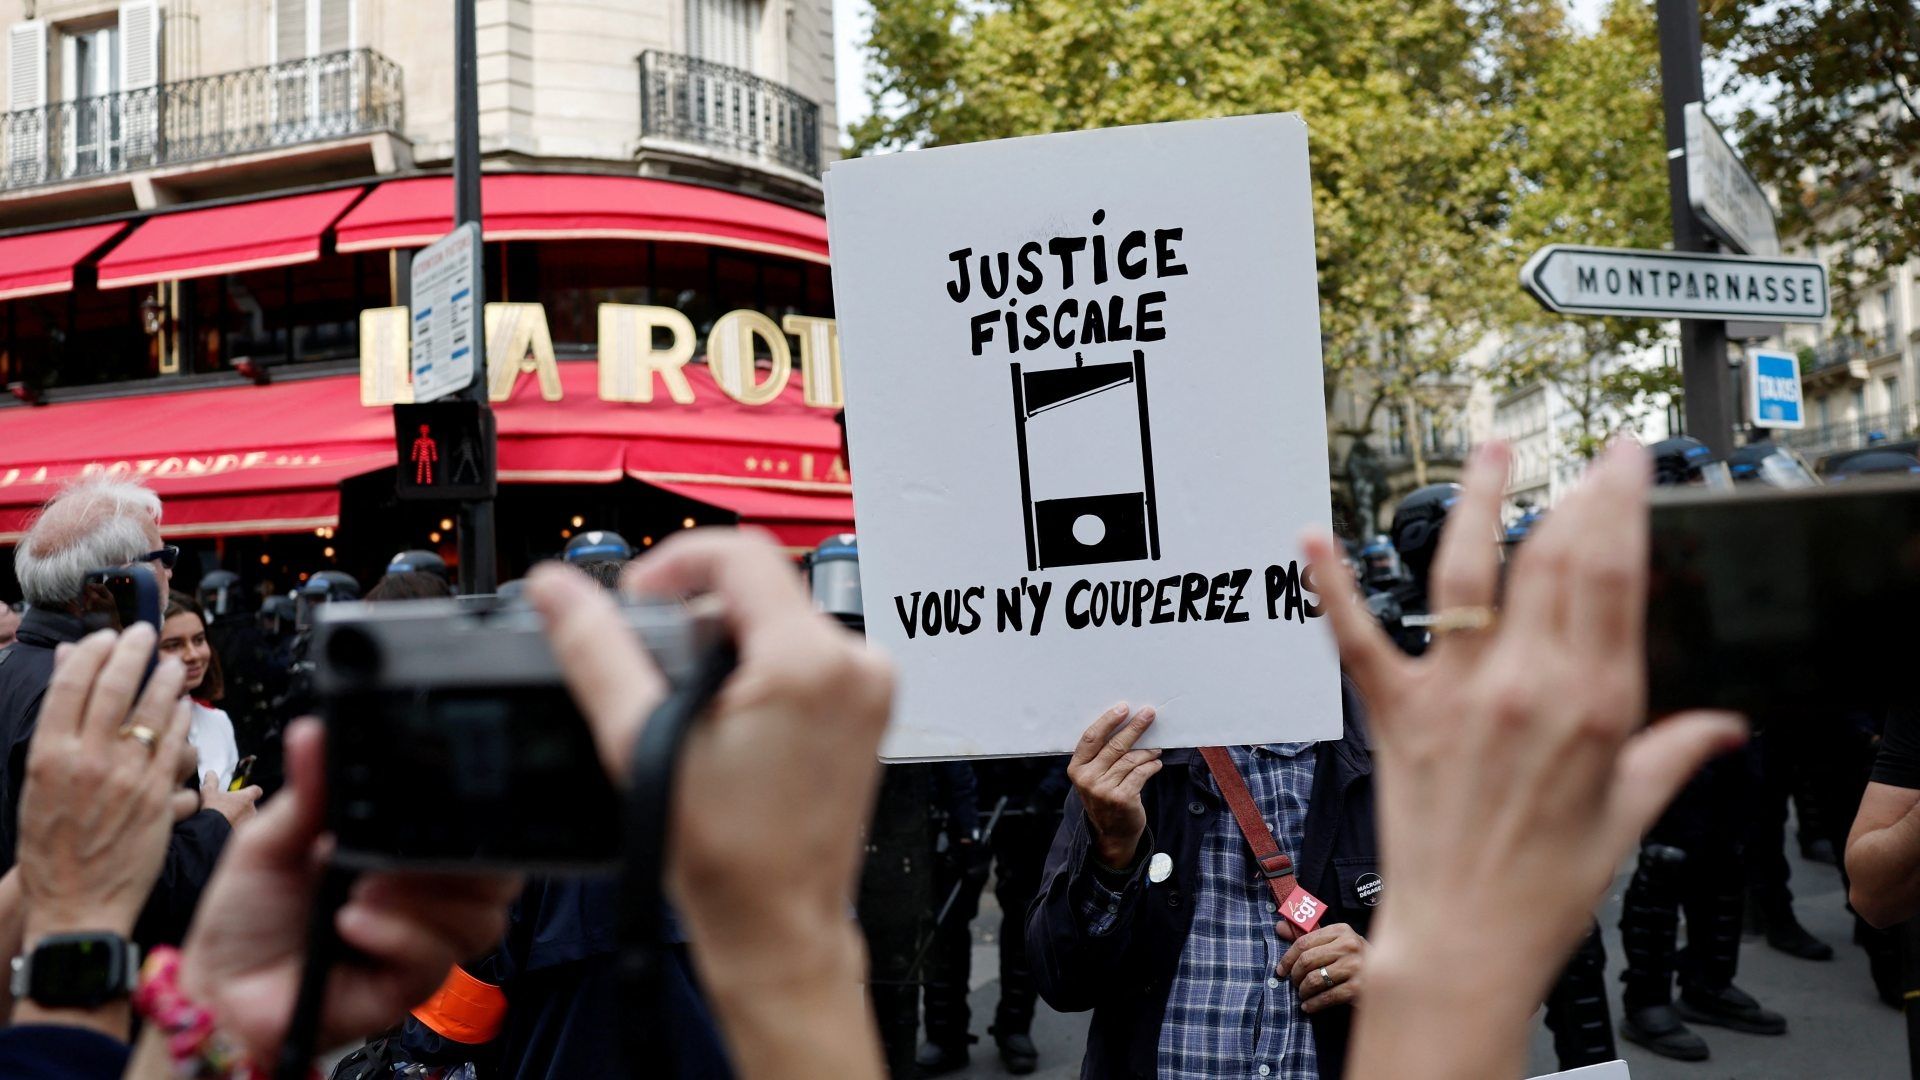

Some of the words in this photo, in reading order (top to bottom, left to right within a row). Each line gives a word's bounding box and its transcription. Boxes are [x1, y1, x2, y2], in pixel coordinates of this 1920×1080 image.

[1578, 266, 1816, 304] MONTPARNASSE
[361, 302, 563, 406] LA
[1759, 374, 1798, 401] TAXIS
[894, 586, 984, 639] VOUS
[997, 577, 1052, 636] N'Y
[1065, 568, 1252, 630] COUPEREZ
[1357, 880, 1381, 893] MACRON
[1294, 895, 1318, 923] cgt
